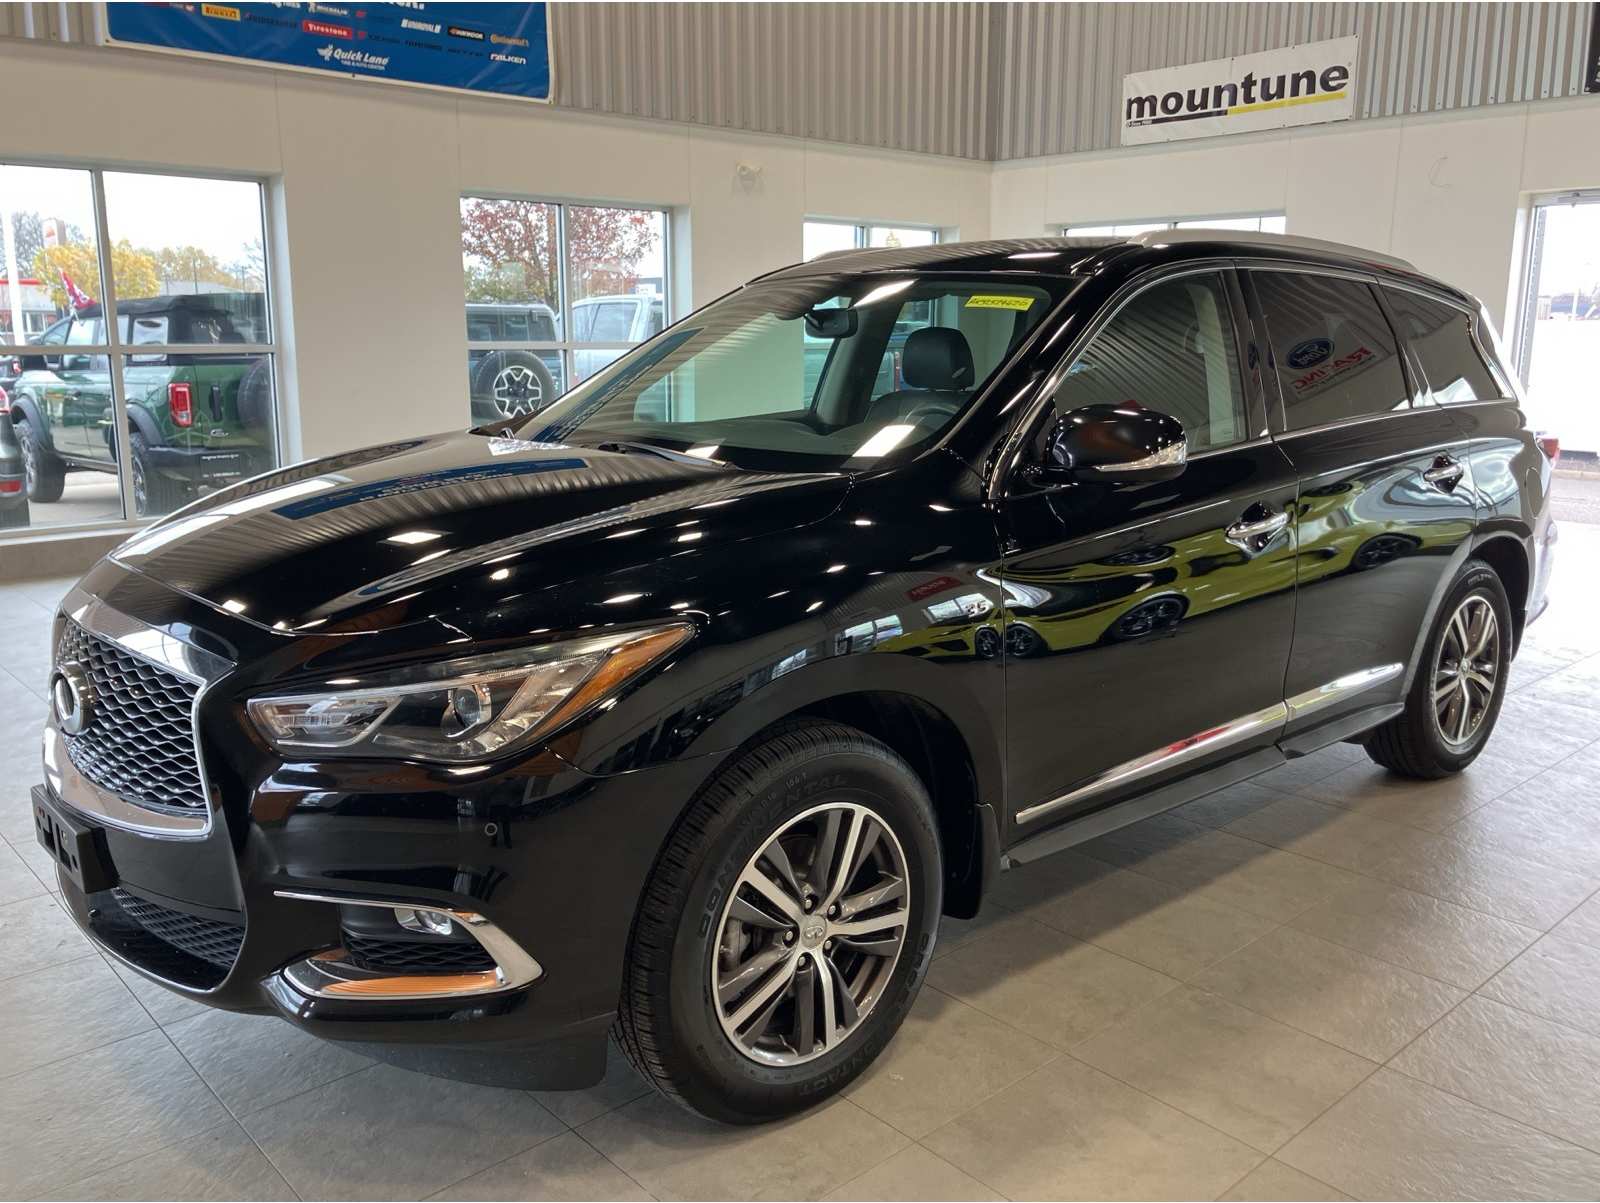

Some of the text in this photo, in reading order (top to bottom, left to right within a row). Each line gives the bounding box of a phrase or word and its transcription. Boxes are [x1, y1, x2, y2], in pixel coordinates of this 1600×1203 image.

[307, 23, 349, 36] Firestone
[334, 47, 390, 65] Quick Lane
[490, 53, 526, 65] FALKEN
[1126, 65, 1349, 120] mountune
